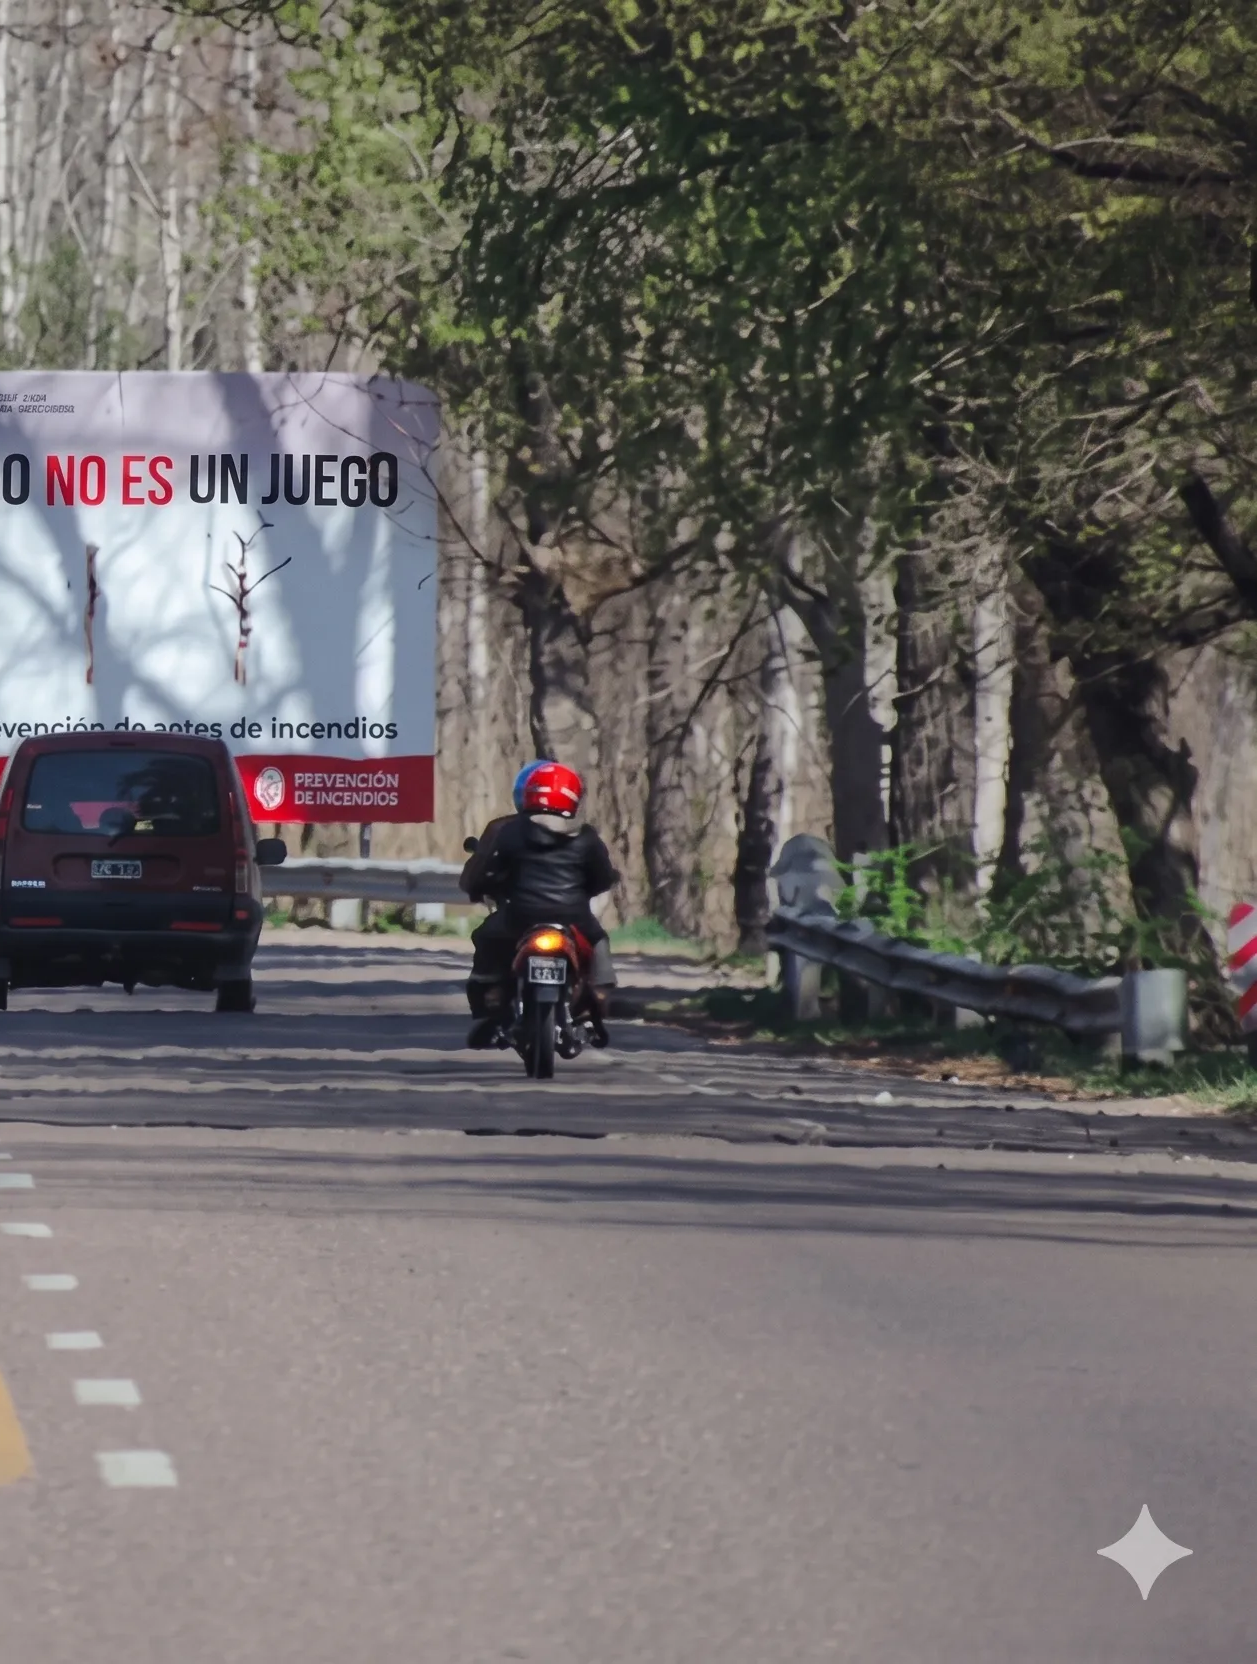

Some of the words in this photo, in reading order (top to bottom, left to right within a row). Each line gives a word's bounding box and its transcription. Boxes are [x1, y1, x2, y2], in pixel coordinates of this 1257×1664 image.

[46, 455, 106, 506] NO
[122, 455, 174, 506] ES
[189, 453, 248, 505] UN
[261, 451, 398, 507] JUEGO
[230, 717, 262, 739] de
[271, 716, 398, 739] incendios
[294, 770, 399, 788] PREVENCIÓN
[294, 790, 314, 805] DE
[316, 791, 399, 806] INCENDIOS
